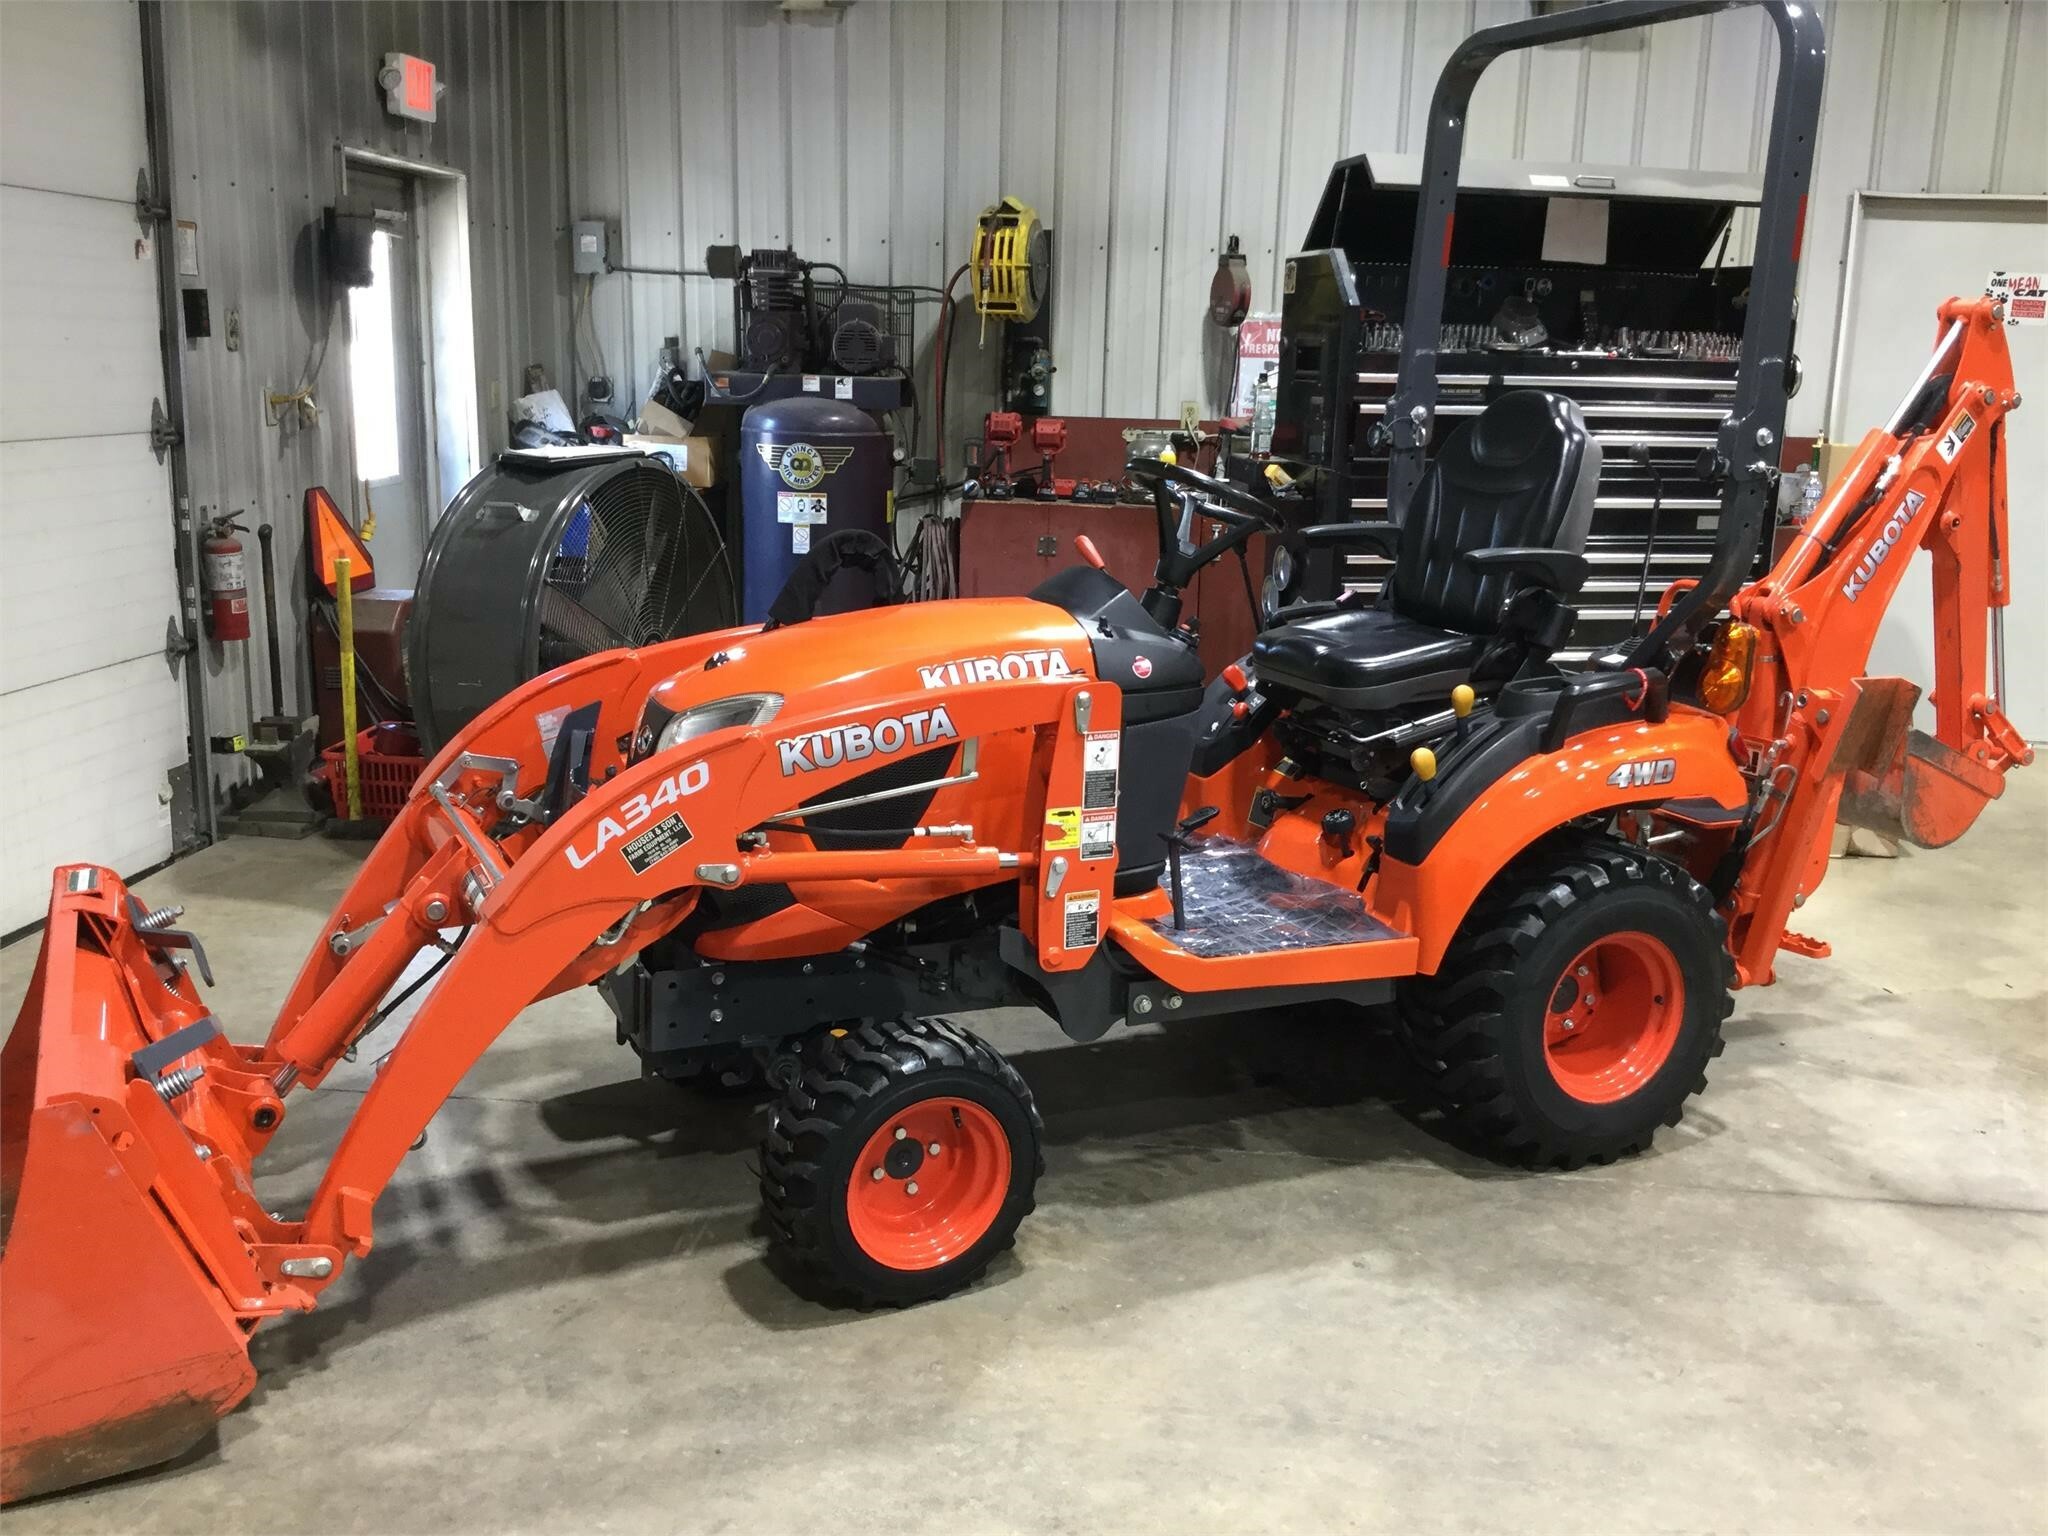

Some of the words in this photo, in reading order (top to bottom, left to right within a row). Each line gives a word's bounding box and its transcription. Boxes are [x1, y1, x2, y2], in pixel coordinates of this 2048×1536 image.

[1991, 279, 2008, 287] ONE
[2008, 277, 2039, 290] MEAN
[2013, 289, 2048, 297] CAT
[1243, 343, 1279, 355] TRESPA
[786, 445, 818, 458] QUINCY
[783, 464, 793, 479] AIR
[793, 465, 821, 484] MASTER
[1842, 488, 1926, 602] KUBOTA
[918, 649, 1071, 689] KUBOTA
[777, 704, 959, 777] KUBOTA
[1093, 732, 1118, 741] DANGER
[1606, 758, 1676, 789] 4WD
[565, 760, 709, 869] LA340
[626, 832, 655, 853] HOUSER
[654, 827, 662, 836] &
[661, 816, 677, 830] SON
[627, 848, 644, 862] FARM
[673, 823, 684, 832] LLC
